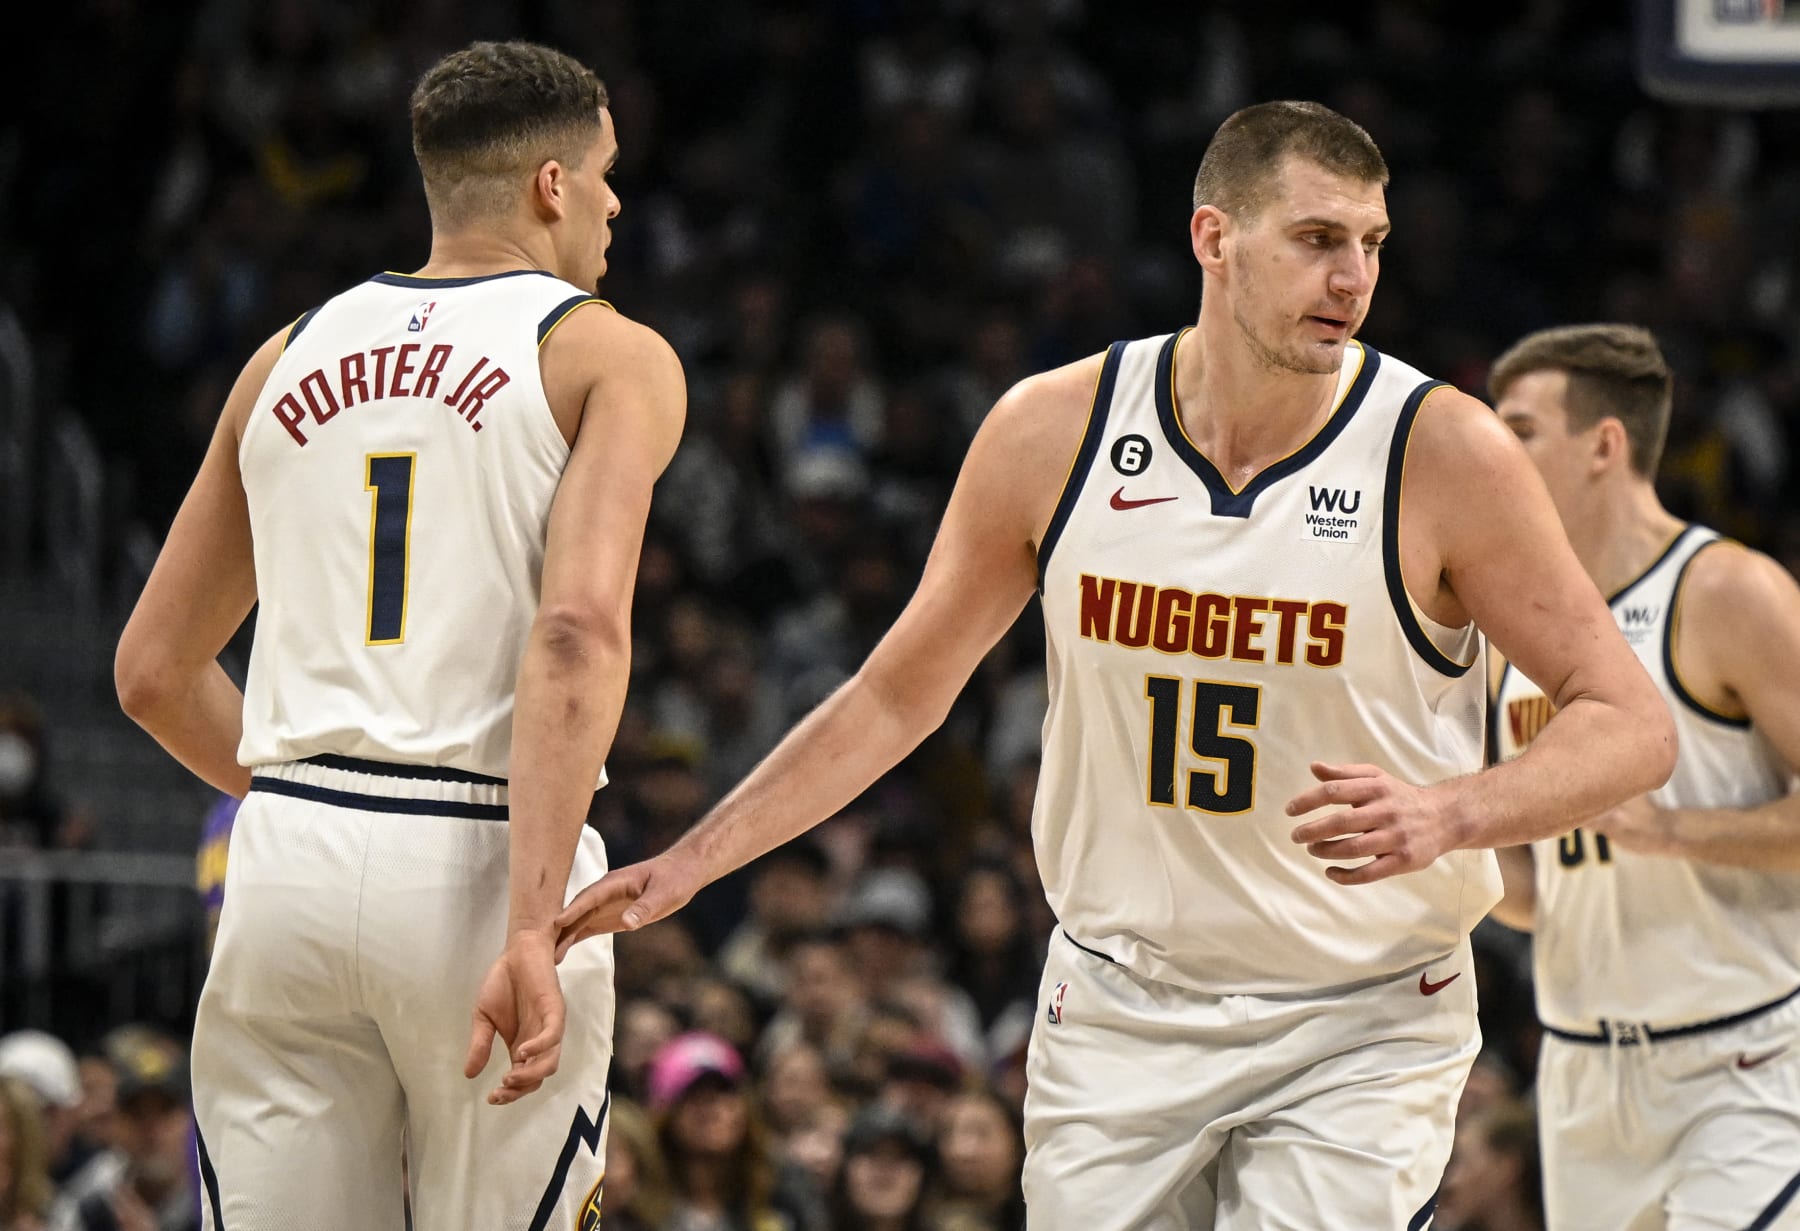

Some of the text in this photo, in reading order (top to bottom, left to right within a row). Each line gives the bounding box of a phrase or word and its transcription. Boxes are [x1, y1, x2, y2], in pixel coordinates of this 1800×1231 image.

[273, 344, 510, 447] PORTER JR.
[1119, 441, 1145, 472] 6
[1305, 513, 1357, 528] Western
[1309, 486, 1360, 514] WU
[365, 452, 417, 646] 1
[1312, 526, 1349, 539] Union
[1080, 573, 1348, 668] NUGGETS
[1144, 674, 1262, 816] 15
